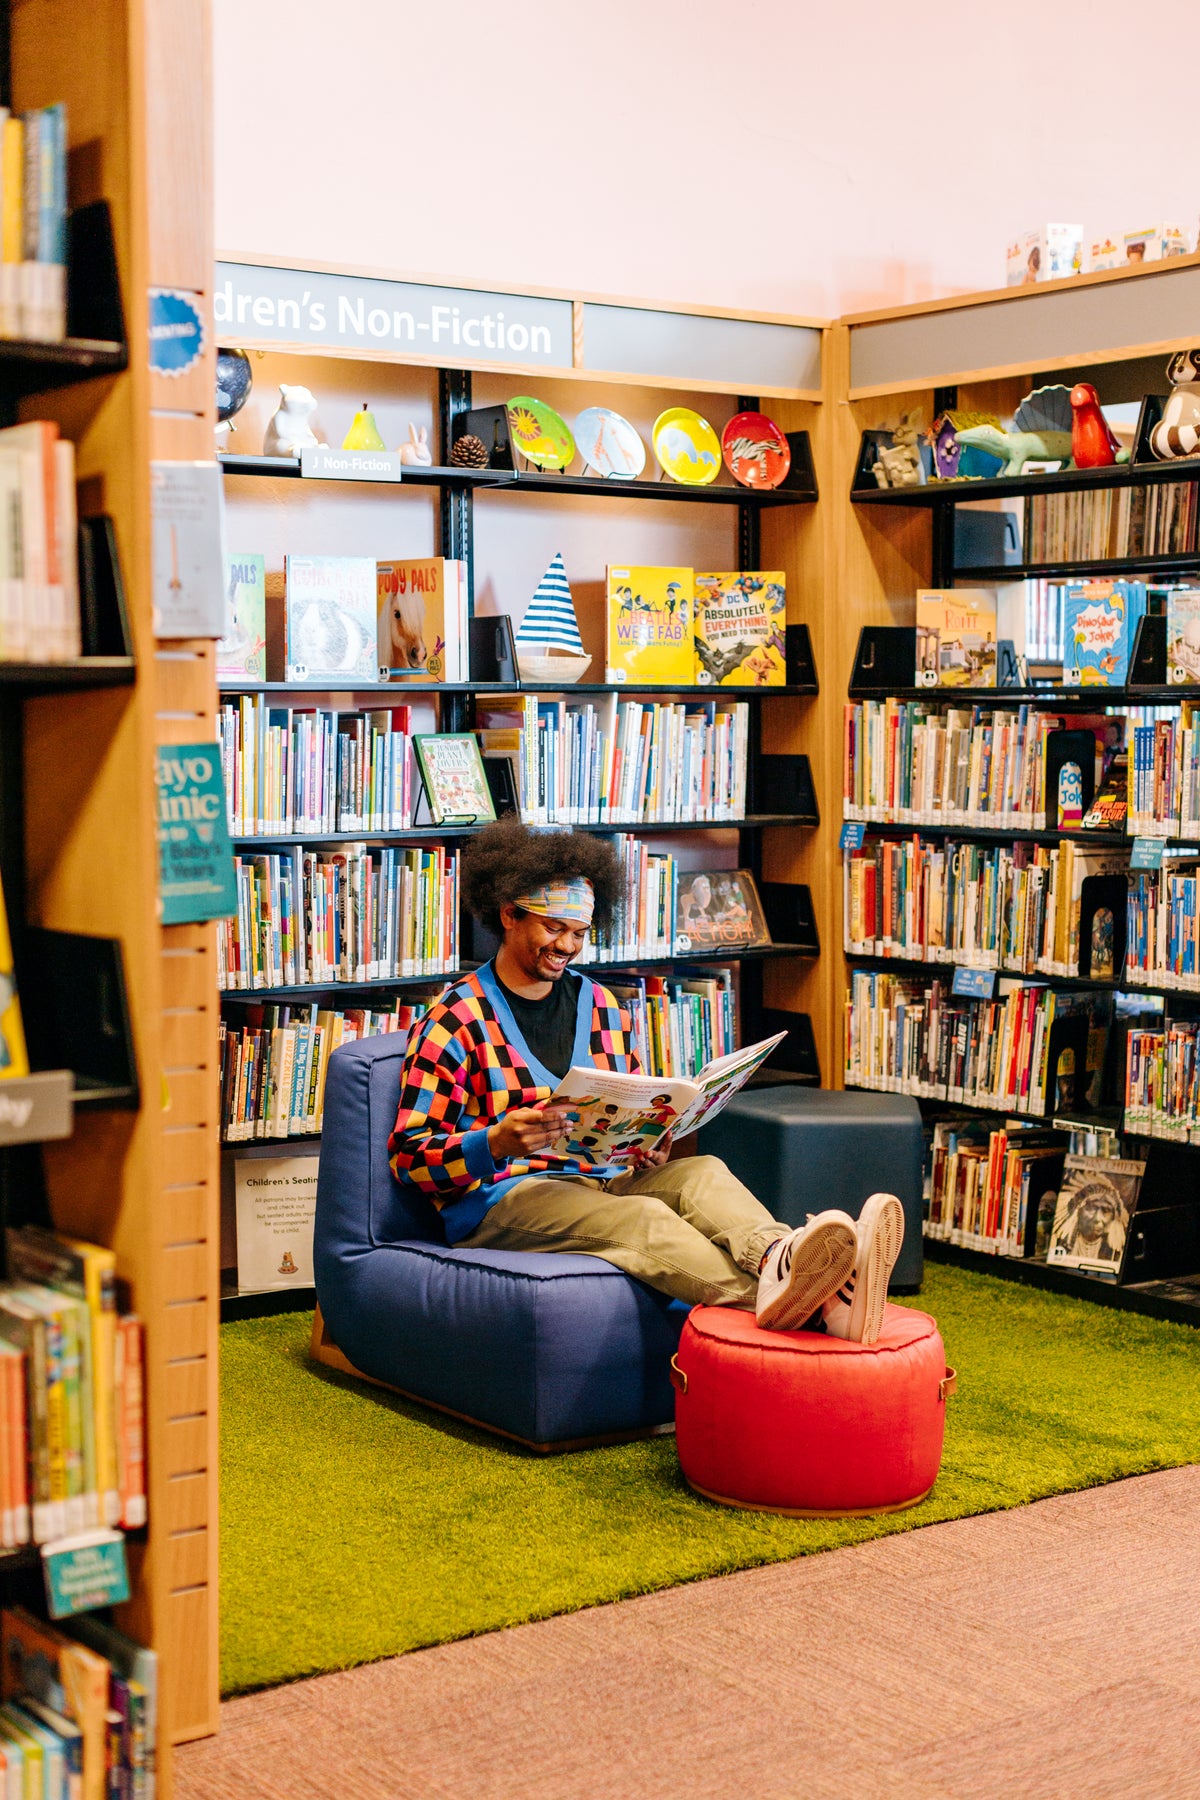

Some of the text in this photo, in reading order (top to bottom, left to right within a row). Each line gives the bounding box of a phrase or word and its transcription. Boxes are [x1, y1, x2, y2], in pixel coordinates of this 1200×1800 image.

[338, 295, 552, 354] Non-Fiction
[312, 456, 391, 471] J Non-Fiction
[378, 567, 437, 595] PONY PALS
[726, 594, 740, 604] DC
[630, 610, 682, 626] BEATLES
[704, 603, 766, 620] ABSOLUTELY
[705, 616, 768, 633] EVERYTHING
[658, 625, 682, 640] FAB
[706, 633, 720, 641] YOU
[721, 630, 737, 638] NEED
[687, 910, 756, 942] ACTION!
[956, 1022, 967, 1056] DIVE!
[299, 1042, 307, 1053] The
[282, 1039, 294, 1088] BUZZKILL
[297, 1065, 305, 1078] Fun
[295, 1078, 304, 1091] Kids
[246, 1177, 290, 1187] Children's
